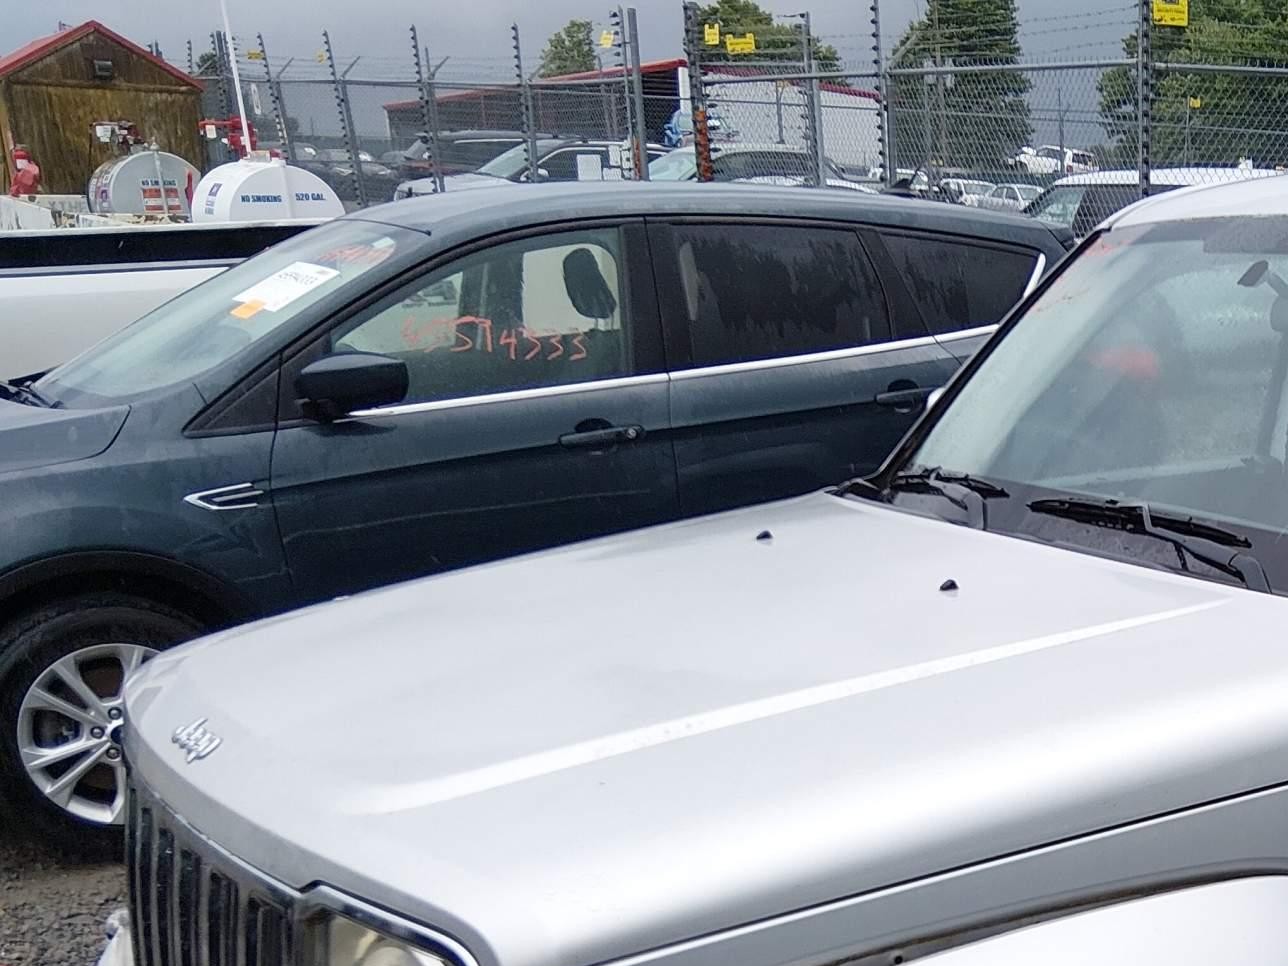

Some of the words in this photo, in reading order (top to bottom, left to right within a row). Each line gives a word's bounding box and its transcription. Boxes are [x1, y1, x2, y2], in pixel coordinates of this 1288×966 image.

[240, 195, 250, 203] NO
[251, 195, 282, 203] SMOKING
[295, 193, 309, 201] 520
